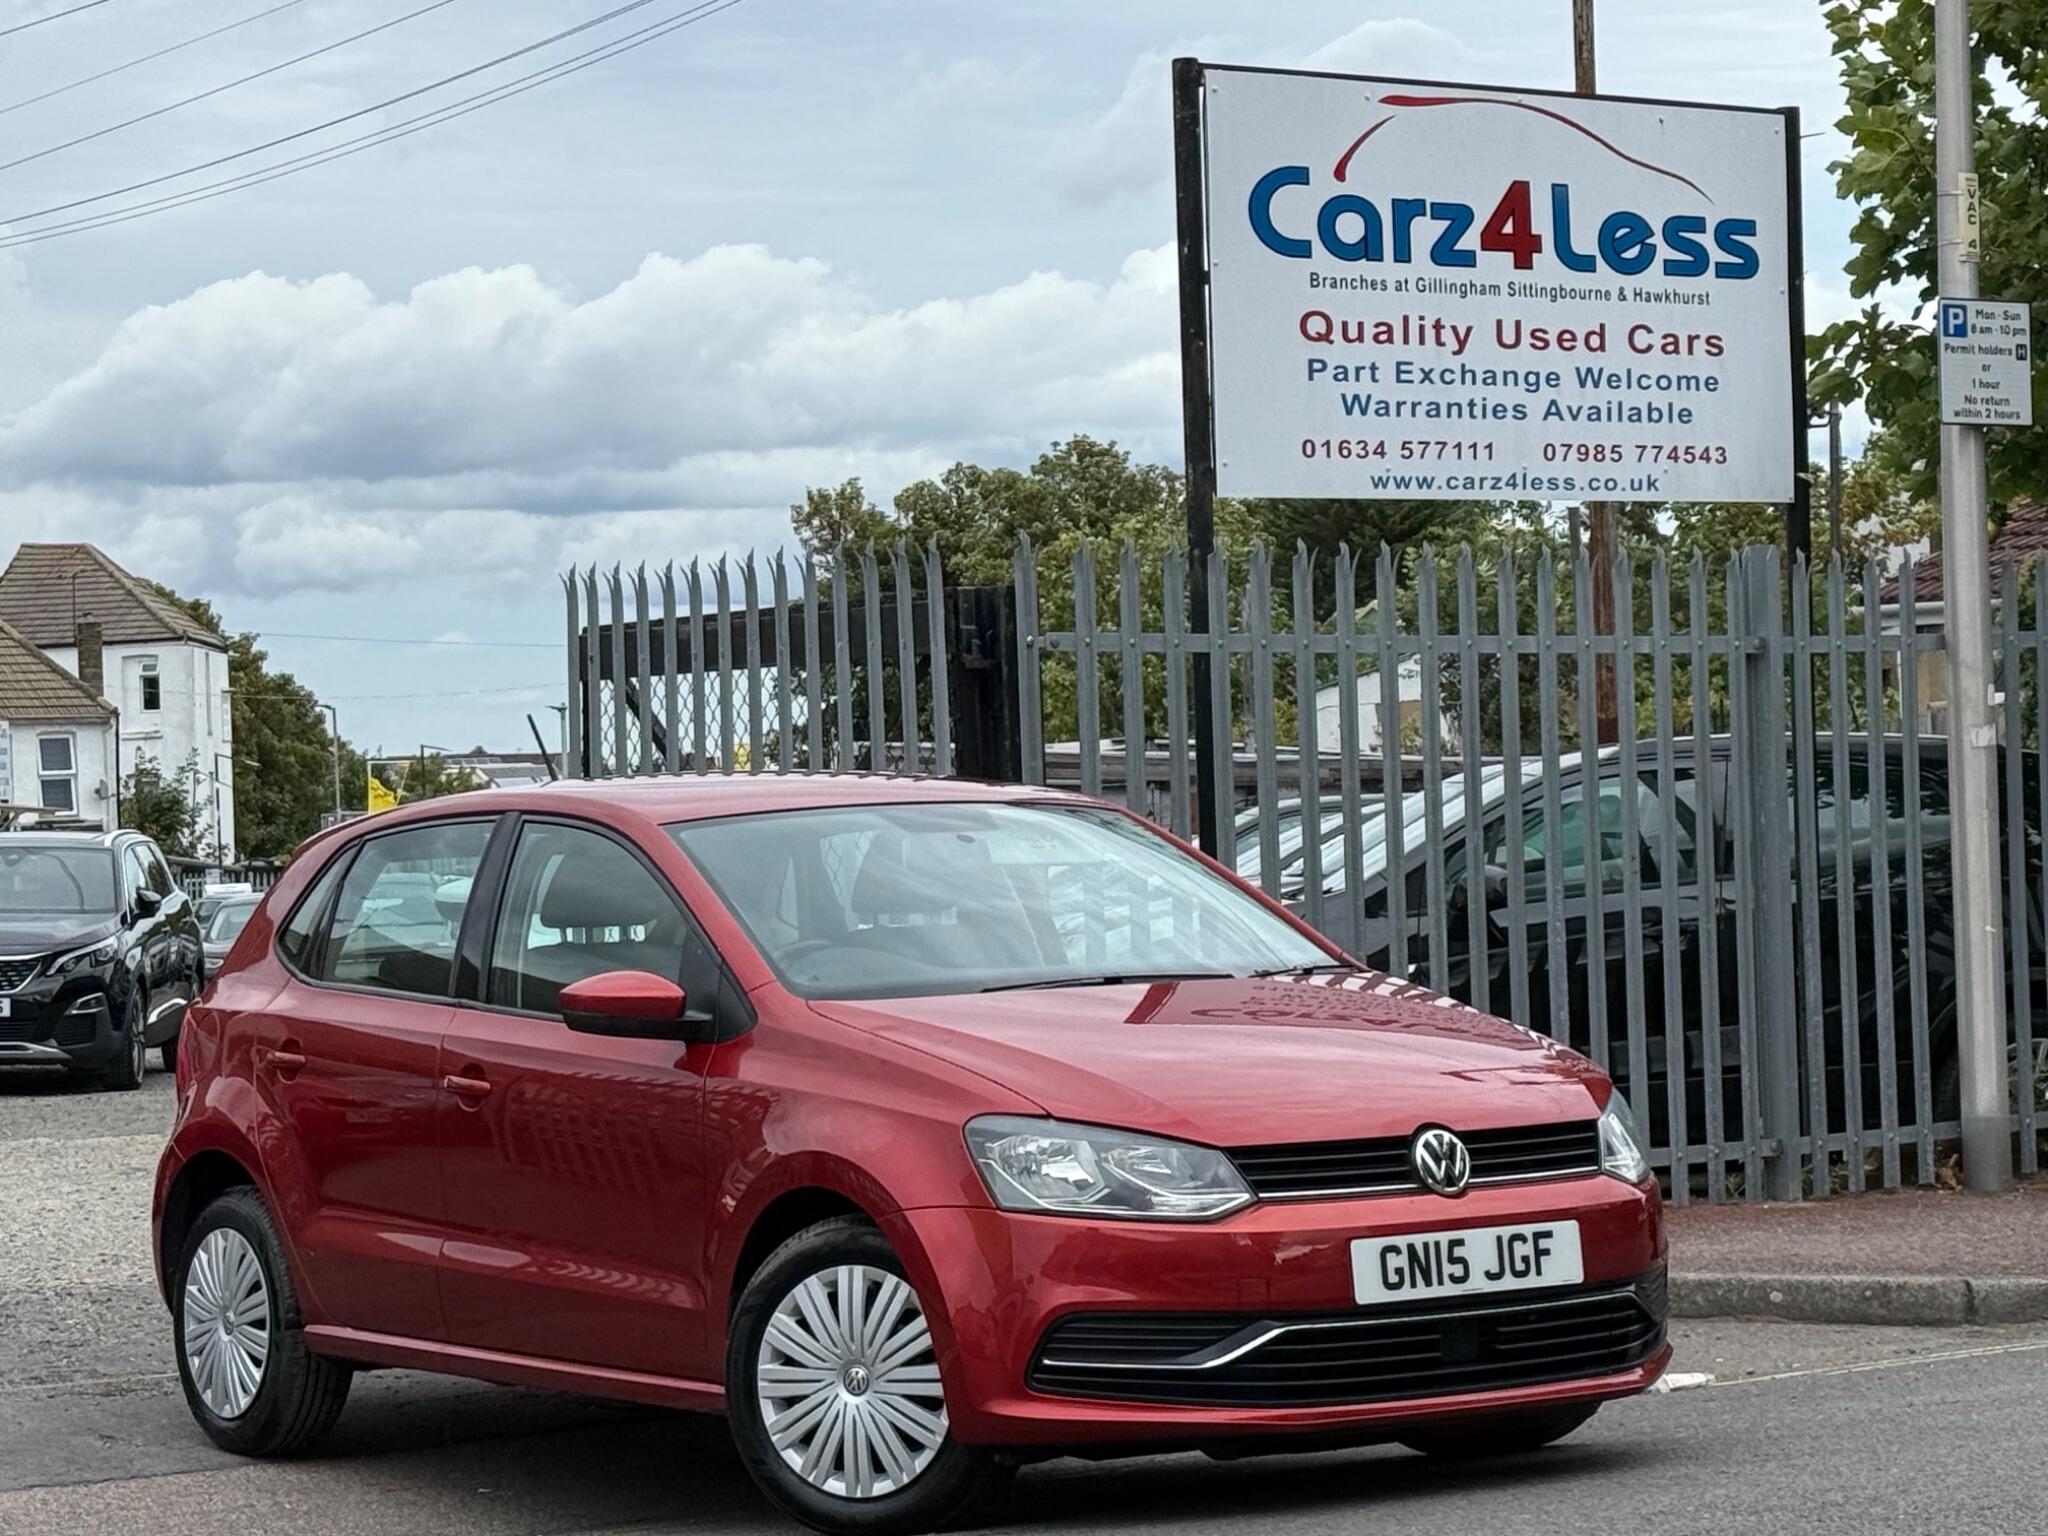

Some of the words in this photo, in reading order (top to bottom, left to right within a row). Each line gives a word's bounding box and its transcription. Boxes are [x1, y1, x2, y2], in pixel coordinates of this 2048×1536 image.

[1247, 165, 1761, 281] Carz4Less
[1309, 271, 1388, 293] Branches
[1394, 277, 1410, 294] at
[1415, 276, 1501, 300] Gillingham
[1507, 280, 1612, 303] Sittingbourne
[1617, 286, 1628, 302] &
[1633, 287, 1710, 306] Hawkhurst
[1948, 307, 1965, 335] P
[1975, 309, 1996, 320] Mon
[2002, 310, 2022, 321] Sun
[1299, 310, 1474, 357] Quality
[1495, 318, 1607, 353] Used
[1627, 323, 1725, 358] Cars
[1978, 325, 1993, 335] am
[1999, 324, 2011, 335] 10
[2012, 327, 2027, 337] pm
[1944, 342, 1976, 355] Permit
[1978, 344, 2013, 356] holders
[1307, 358, 1380, 384] Part
[1395, 360, 1561, 394] Exchange
[1574, 366, 1720, 393] Welcome
[1981, 363, 1992, 372] or
[1978, 379, 2001, 389] hour
[1340, 392, 1528, 421] Warranties
[1542, 398, 1693, 425] Available
[1964, 394, 1977, 405] No
[1980, 395, 2011, 406] return
[1953, 407, 1983, 418] within
[1984, 408, 1992, 419] 2
[1994, 409, 2021, 420] hours
[1301, 438, 1388, 461] 01634
[1400, 440, 1493, 461] 577111
[1543, 442, 1623, 463] 07985
[1634, 444, 1728, 465] 774543
[1370, 471, 1660, 492] www.carz4less.co.uk
[1379, 1238, 1471, 1291] GN15
[1483, 1230, 1554, 1282] JGF
